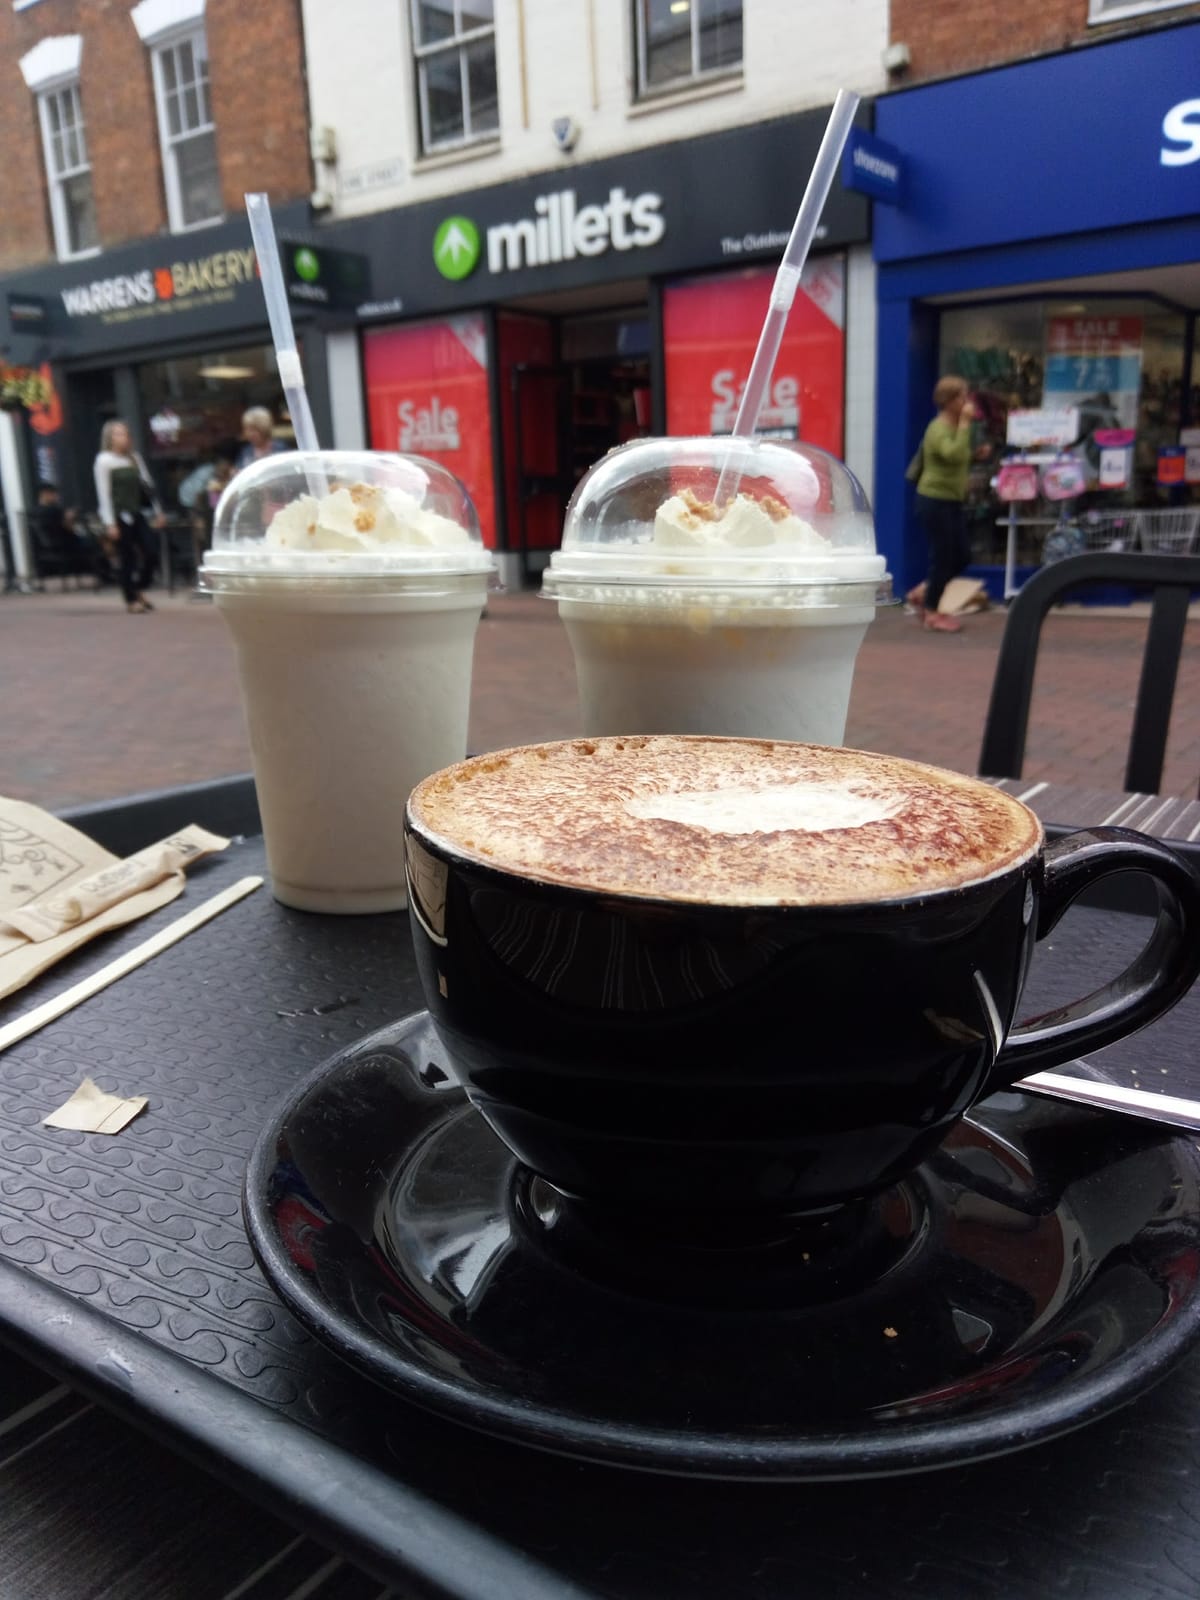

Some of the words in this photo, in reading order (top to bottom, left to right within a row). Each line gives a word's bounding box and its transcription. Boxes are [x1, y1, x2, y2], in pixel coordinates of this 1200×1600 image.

[487, 187, 665, 274] millets
[721, 237, 743, 254] The
[61, 269, 155, 317] WARRENS
[171, 248, 256, 297] BAKERY
[398, 396, 459, 434] Sale
